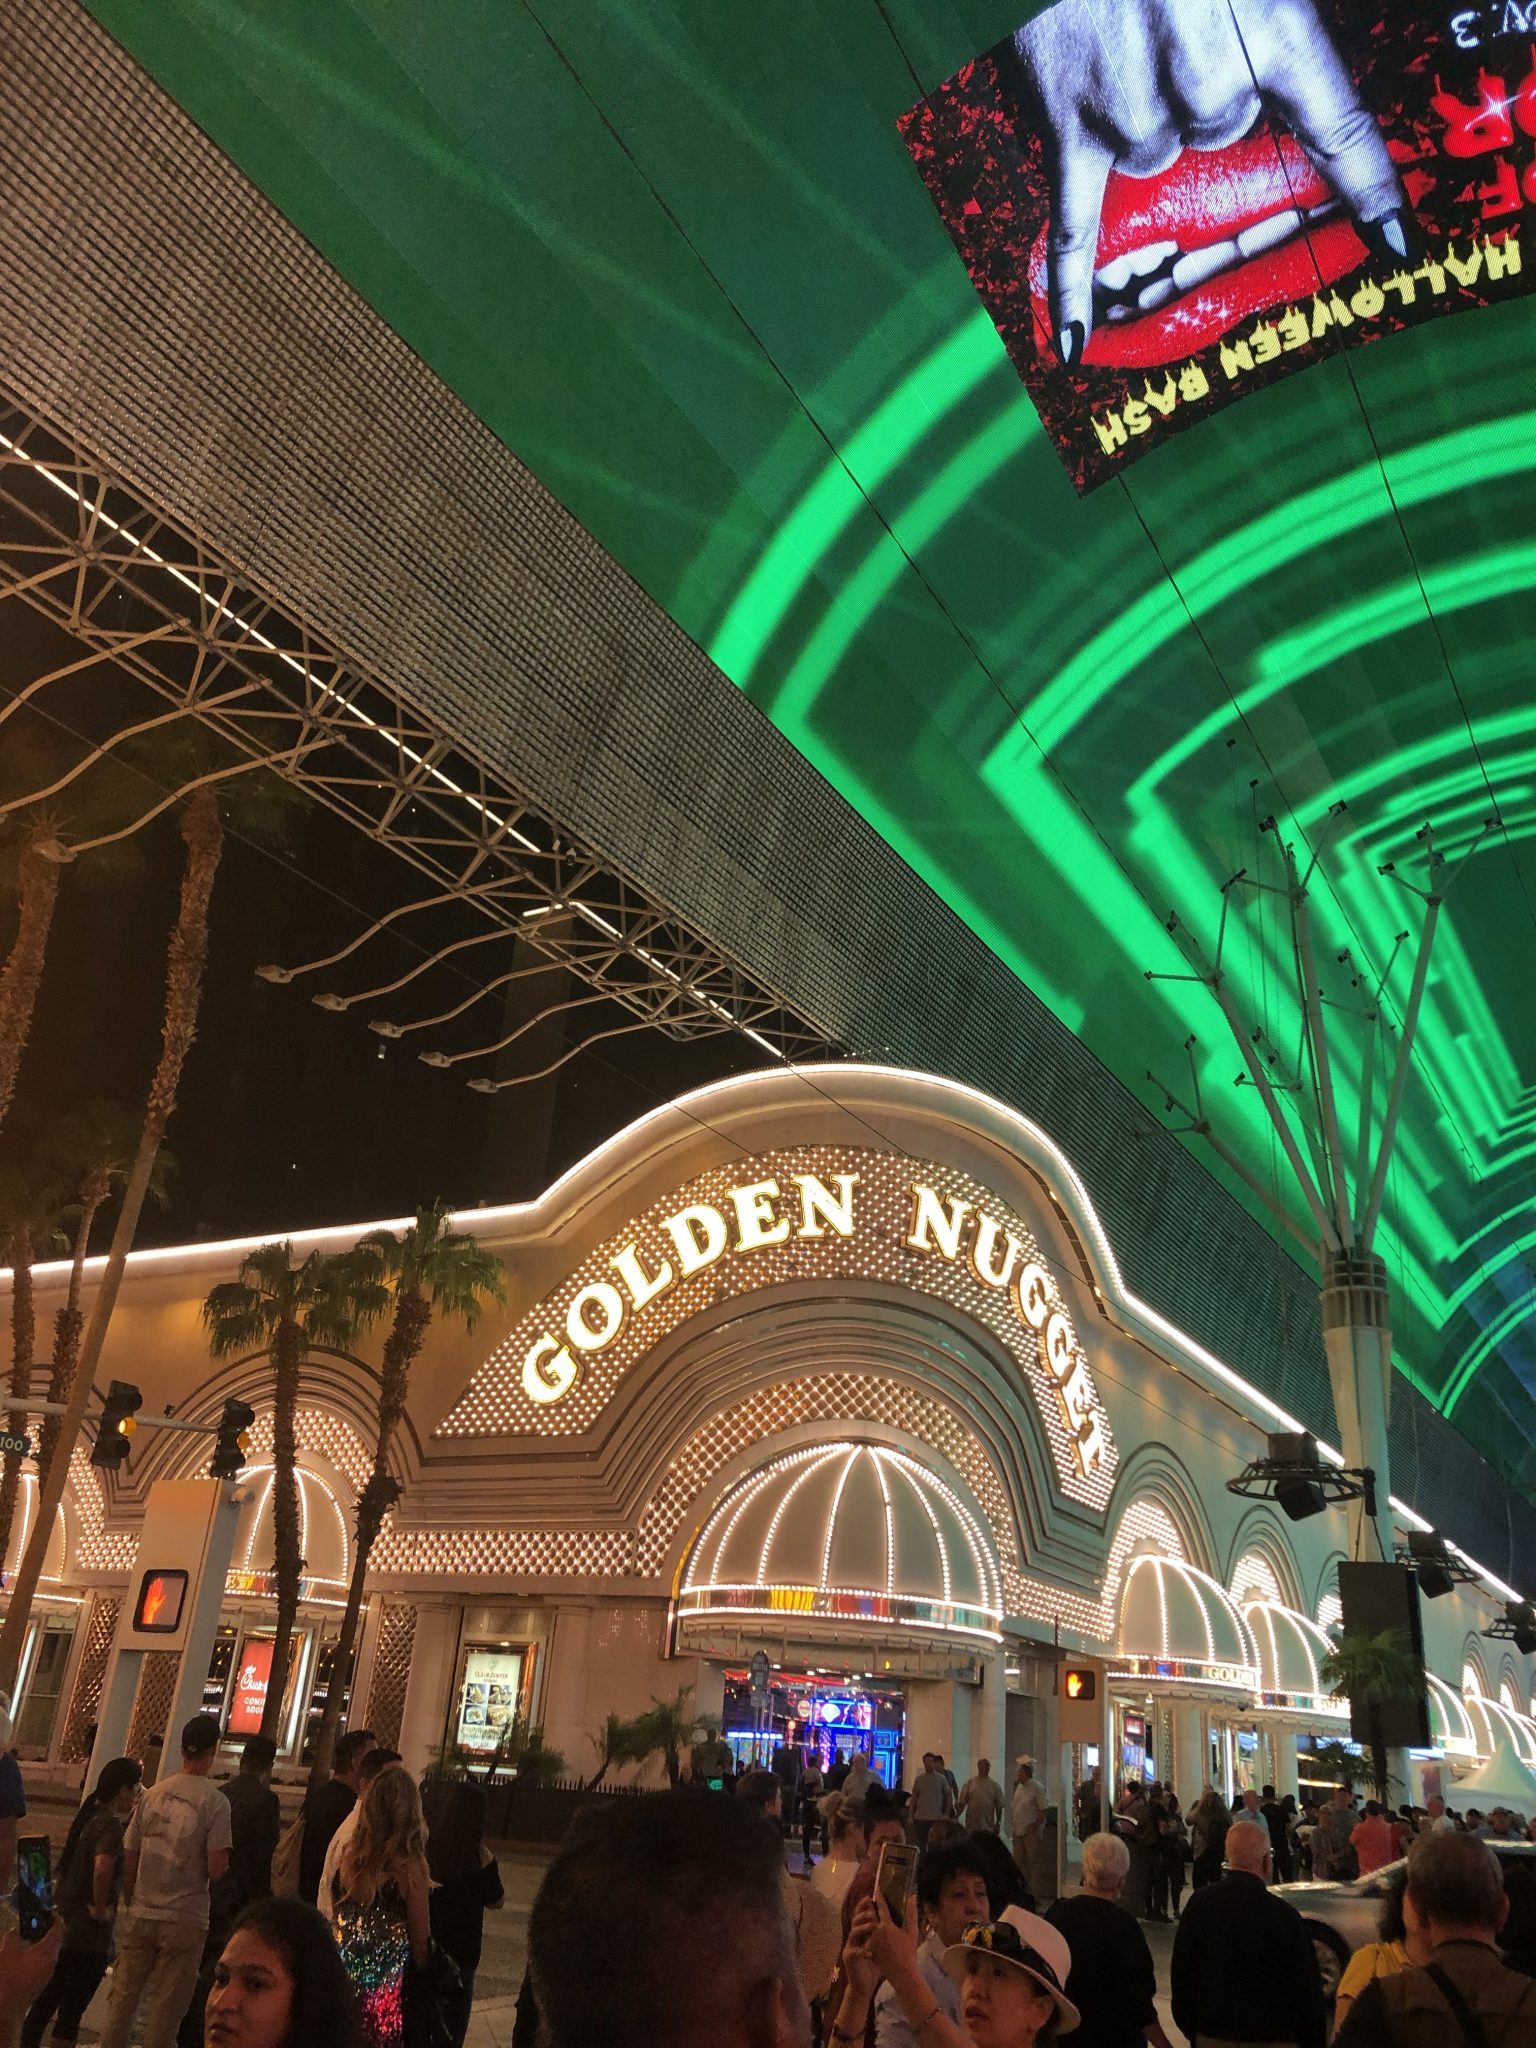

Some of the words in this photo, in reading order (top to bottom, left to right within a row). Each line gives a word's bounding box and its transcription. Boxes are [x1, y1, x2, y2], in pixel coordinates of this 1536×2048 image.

[1450, 11, 1482, 49] 3
[1219, 232, 1522, 379] HALLOWEEN
[1090, 359, 1210, 455] BASH
[520, 1172, 861, 1405] GOLDEN
[902, 1182, 1107, 1482] NUGGET
